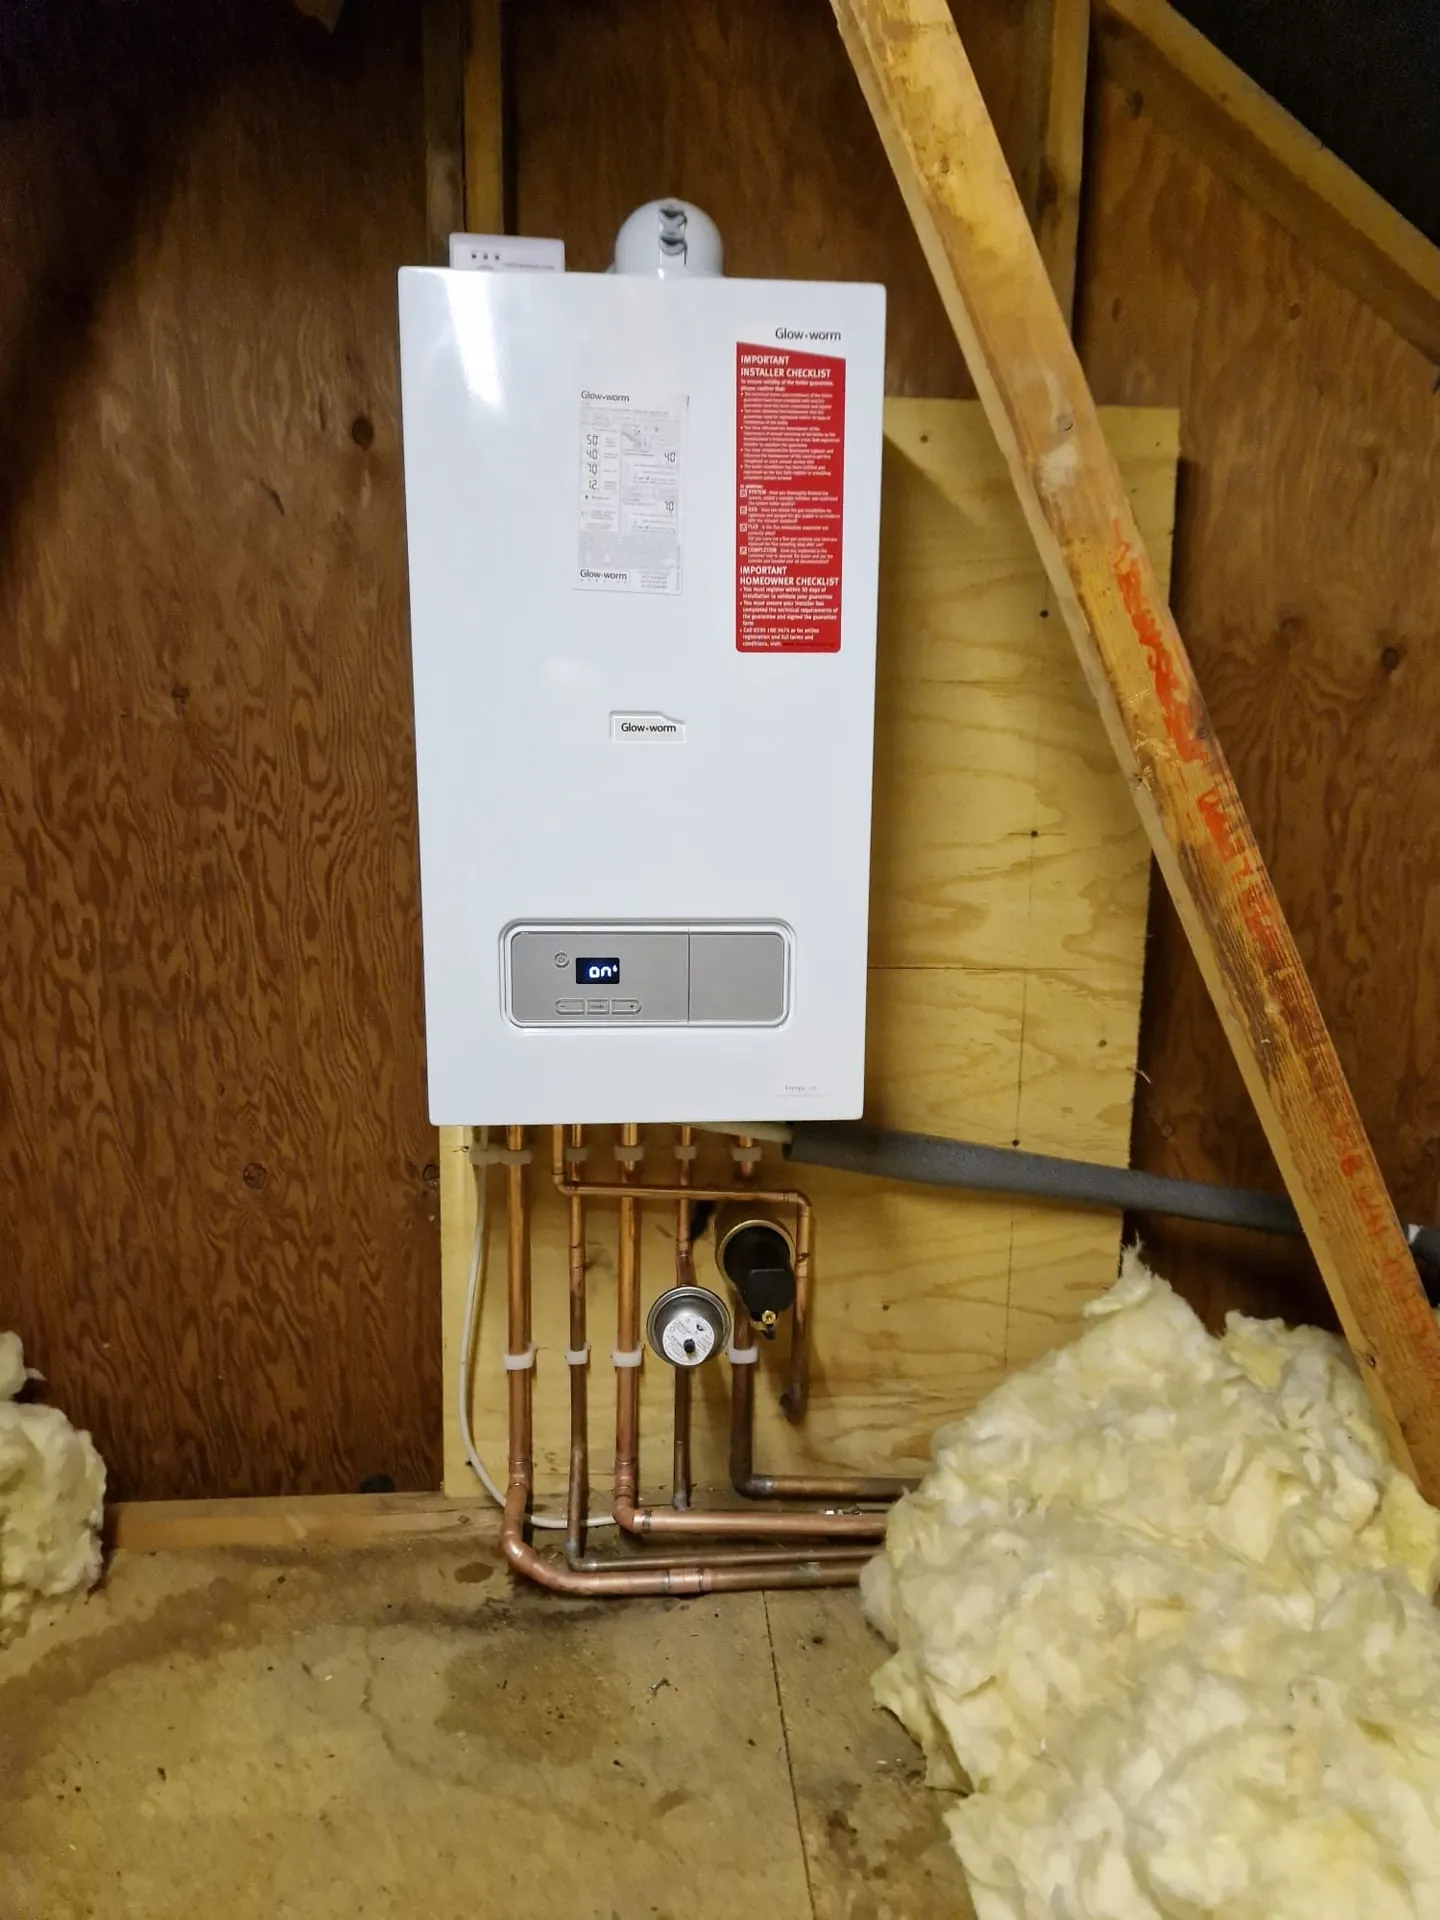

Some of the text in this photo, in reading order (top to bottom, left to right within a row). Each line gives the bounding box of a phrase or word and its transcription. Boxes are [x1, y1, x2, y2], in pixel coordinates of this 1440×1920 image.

[740, 355, 790, 365] IMPORTANT
[740, 367, 832, 378] INSTALLER CHECKLIST
[740, 566, 788, 575] IMPORTANT
[740, 576, 840, 586] HOMEOWNER CHECKLIST
[621, 722, 677, 732] Glow-worm
